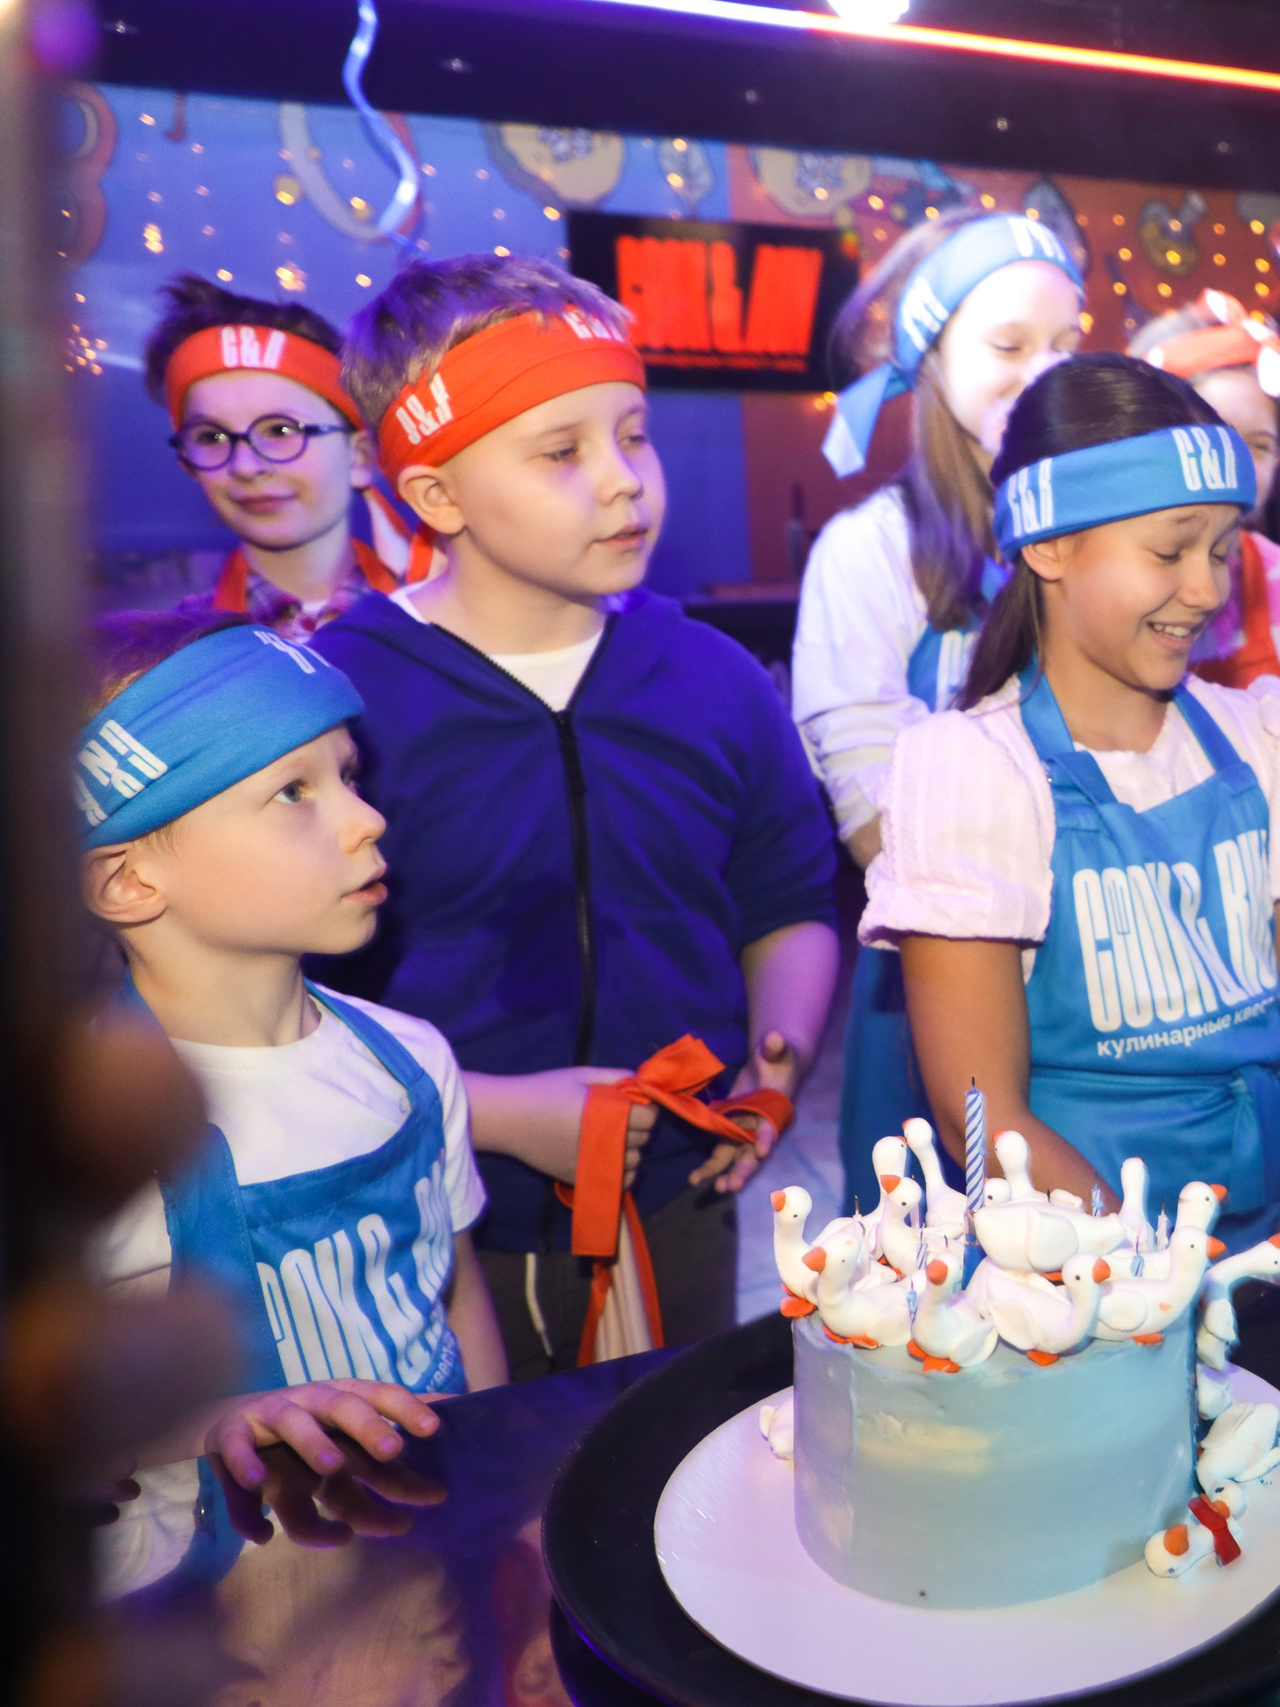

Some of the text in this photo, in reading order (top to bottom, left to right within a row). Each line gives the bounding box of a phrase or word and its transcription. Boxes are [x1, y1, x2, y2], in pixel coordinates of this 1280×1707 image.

[1172, 427, 1238, 491] C&R
[1007, 457, 1053, 538] C&R
[1097, 1013, 1232, 1059] кулинарные
[256, 1229, 401, 1388] OOK
